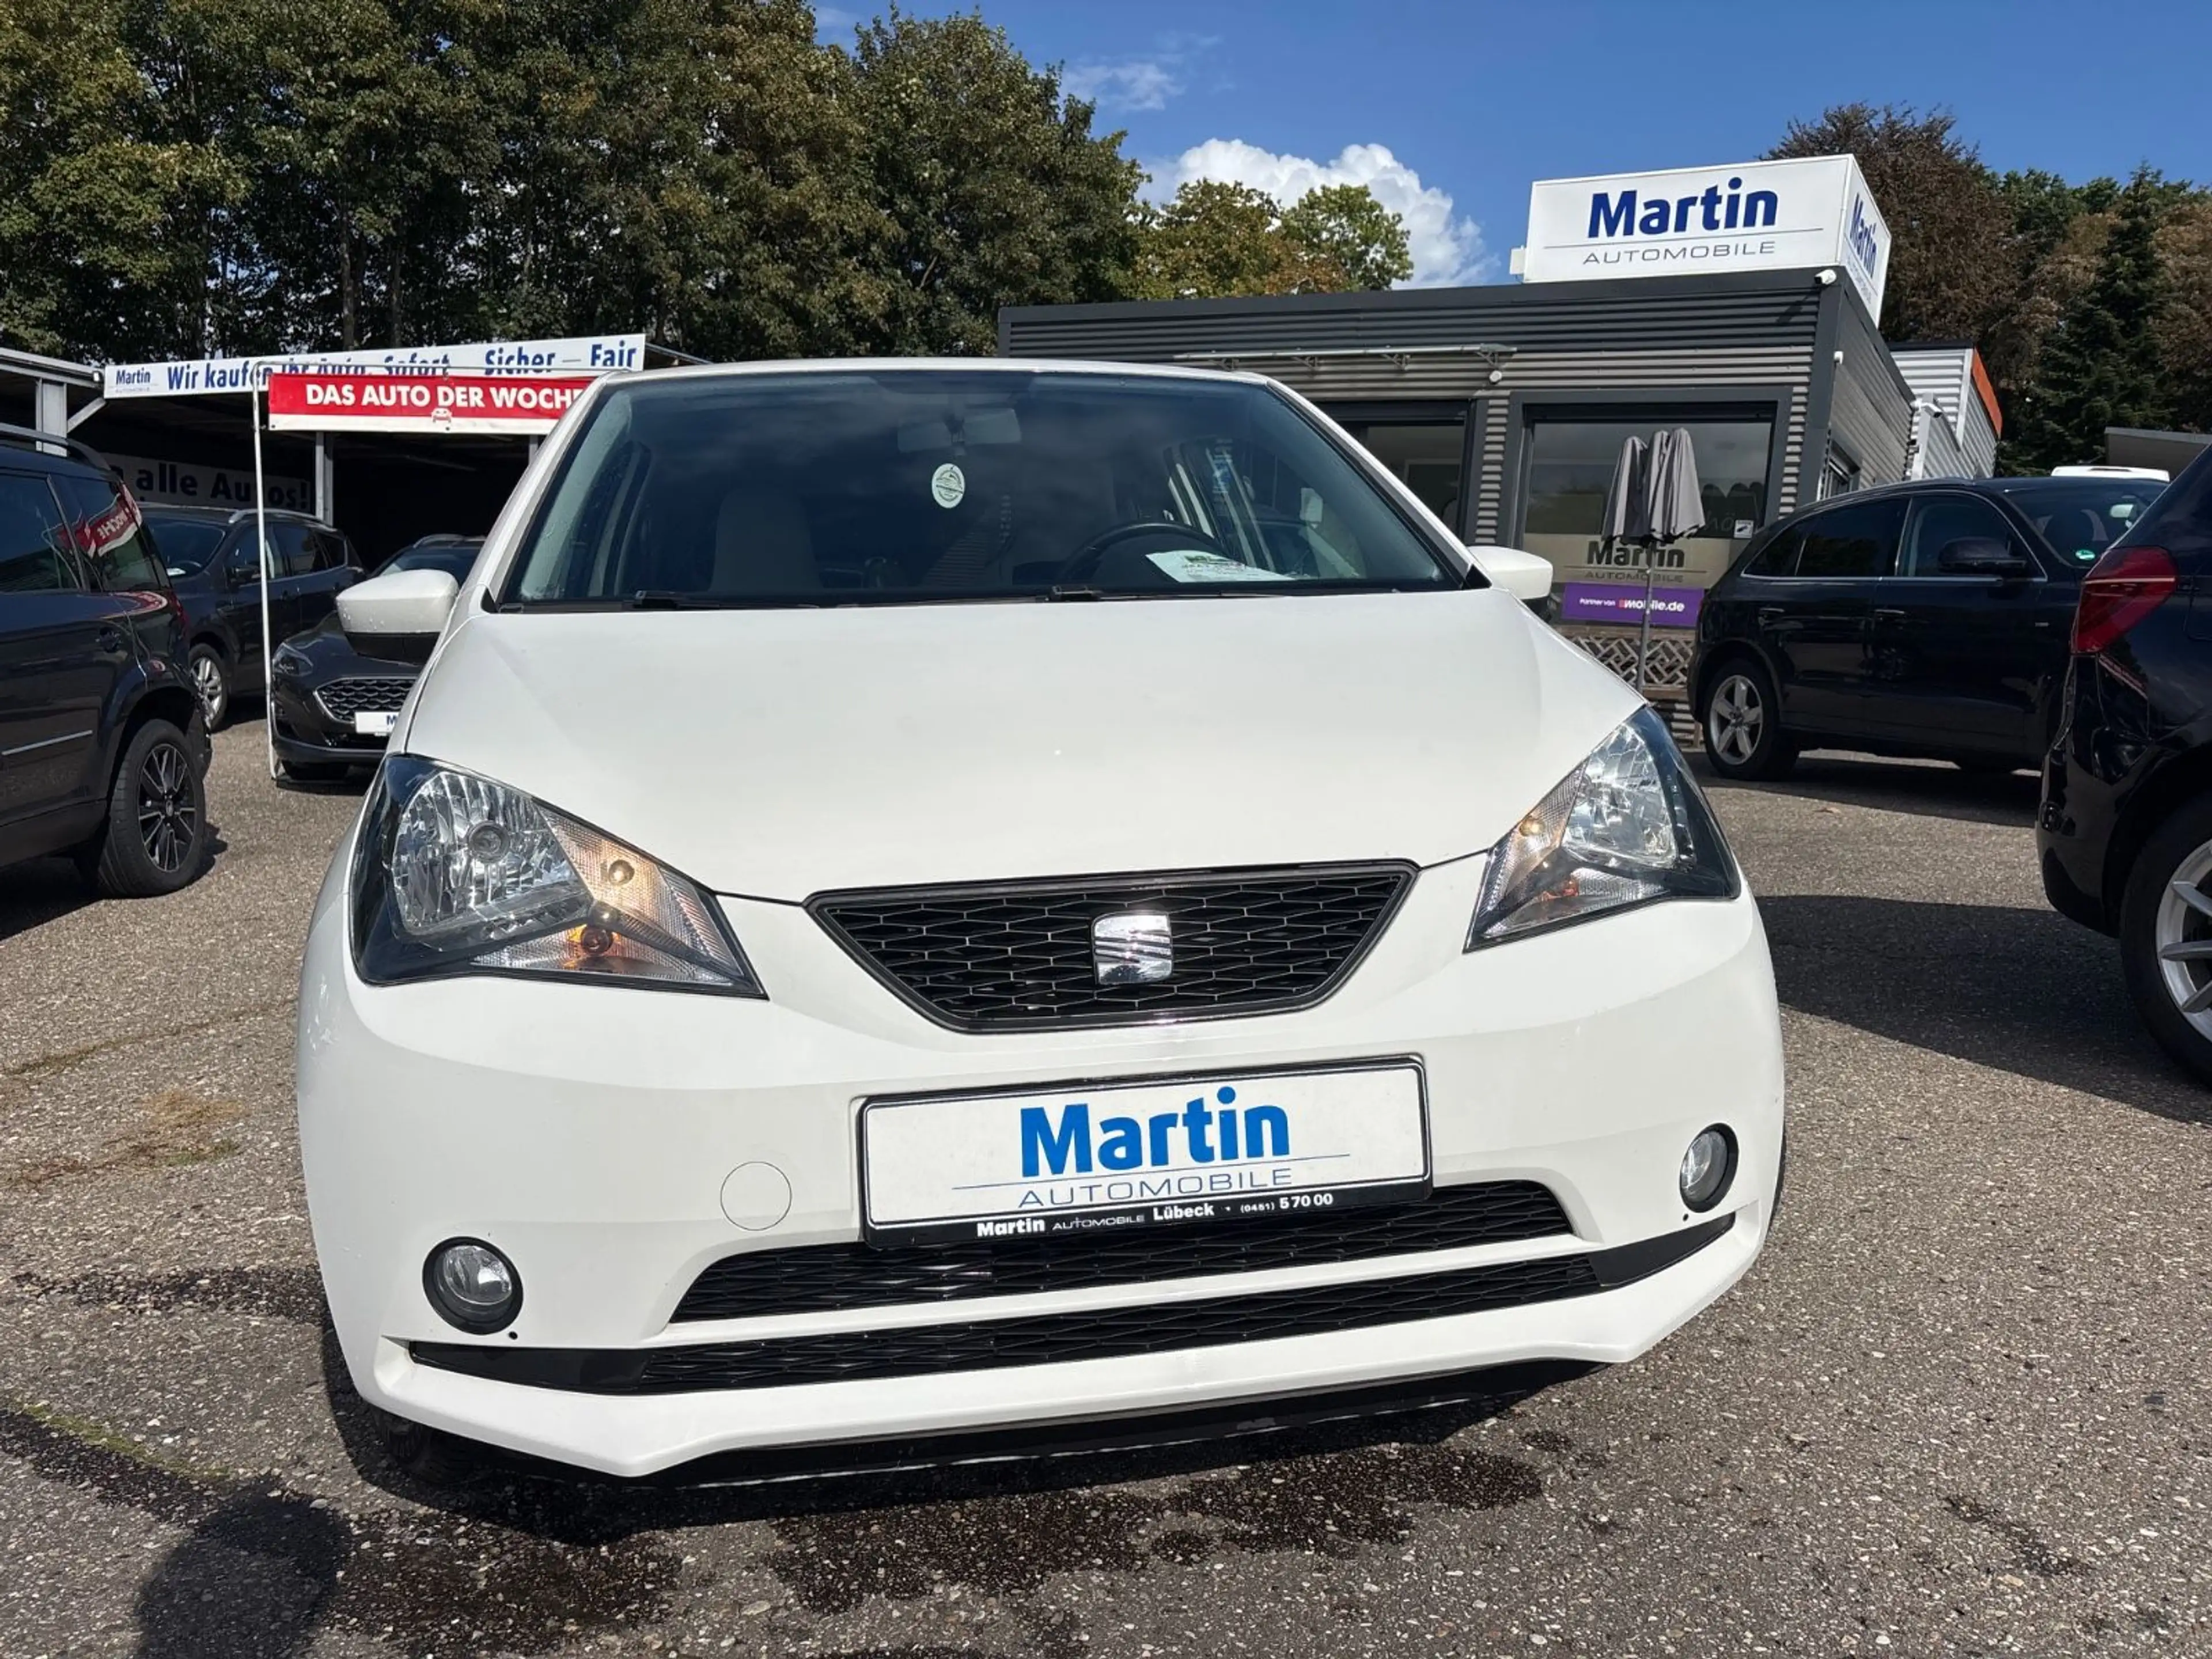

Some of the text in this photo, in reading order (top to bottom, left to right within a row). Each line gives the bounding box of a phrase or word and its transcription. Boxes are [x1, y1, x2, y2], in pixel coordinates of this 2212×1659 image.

[1588, 177, 1778, 238] Martin
[1583, 241, 1775, 264] AUTOMOBILE
[116, 367, 150, 385] Martin
[167, 363, 198, 390] Wir
[590, 340, 637, 368] Fair
[305, 384, 356, 406] DAS
[361, 385, 431, 407] AUTO
[437, 387, 486, 408] DER
[136, 463, 198, 497] alle
[211, 472, 309, 509] Auos!
[1624, 599, 1685, 612] moile.de
[1020, 1086, 1290, 1178] Martin
[1018, 1168, 1292, 1209] AUTOMOBILE
[977, 1217, 1046, 1237] Martin
[1052, 1214, 1145, 1231] AUTOMOBILE
[1153, 1202, 1215, 1221] Lübeck
